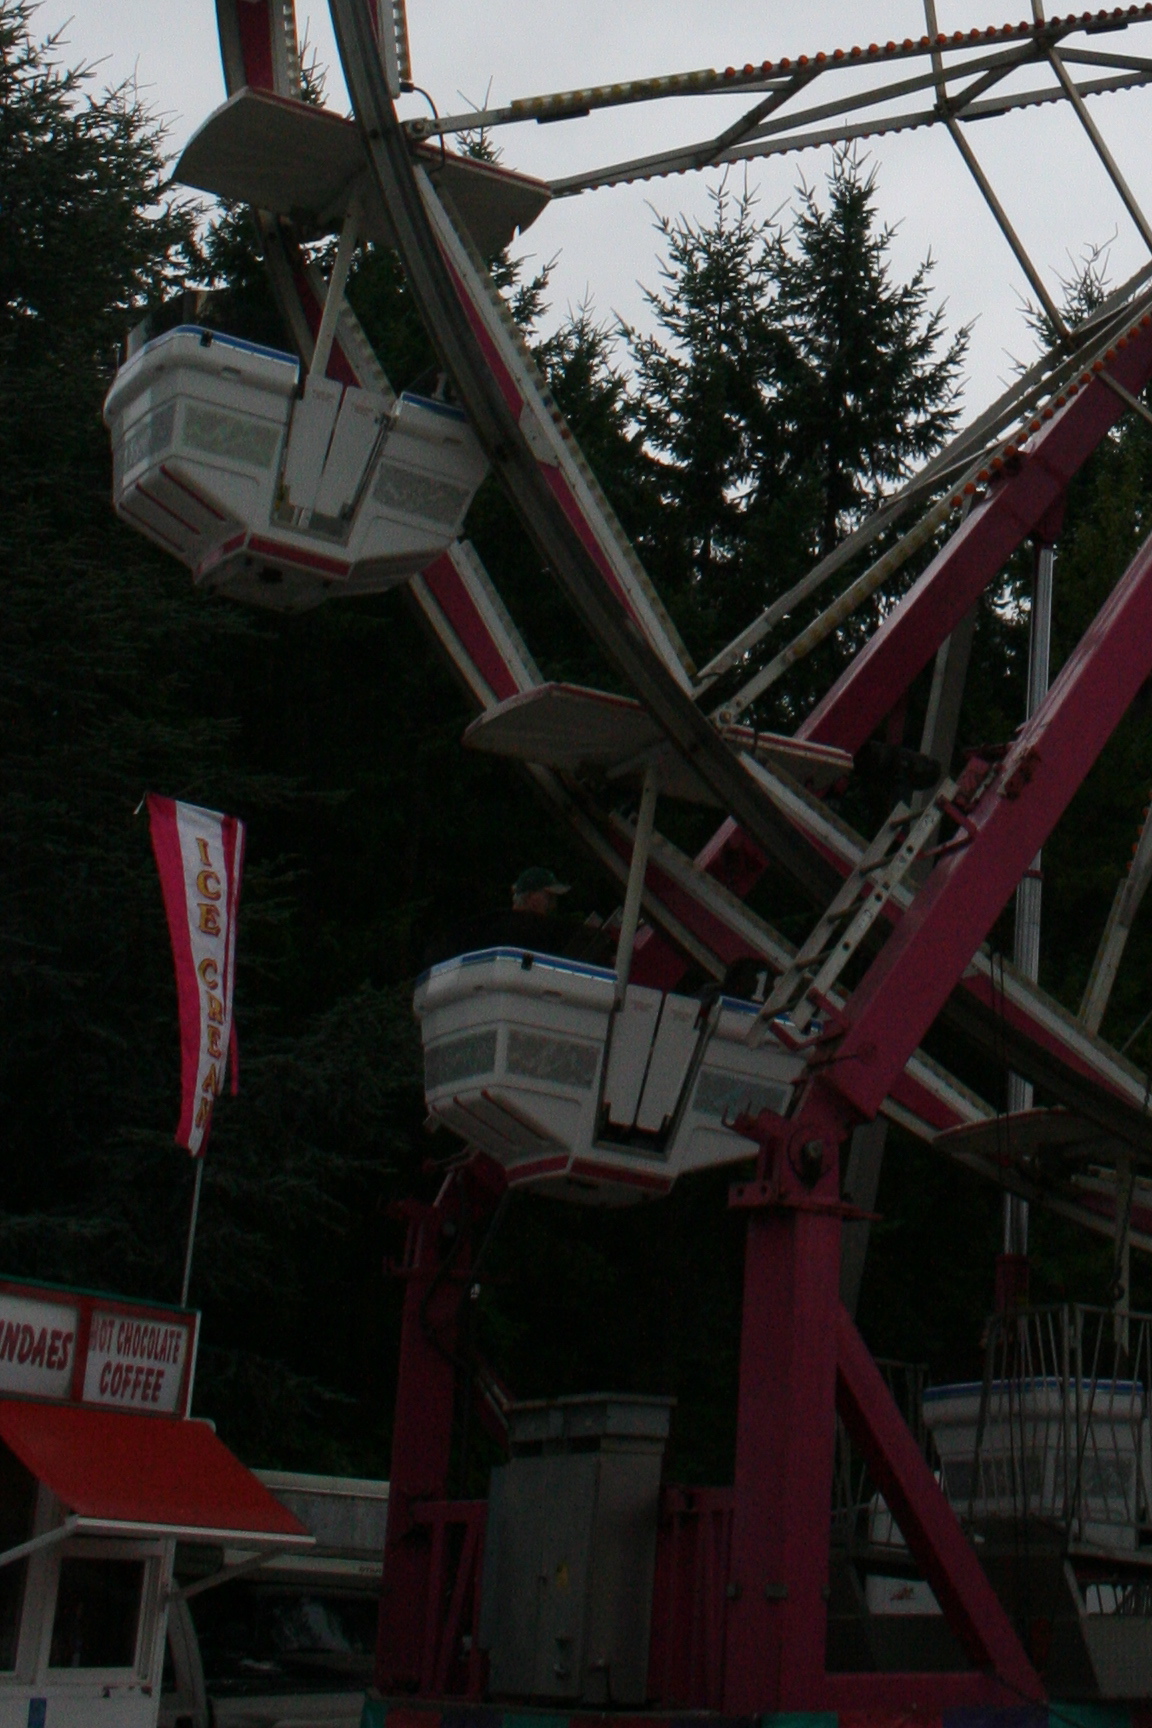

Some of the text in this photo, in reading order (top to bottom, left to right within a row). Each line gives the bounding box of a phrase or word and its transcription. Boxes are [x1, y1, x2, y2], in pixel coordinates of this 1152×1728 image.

[195, 837, 222, 937] ICE
[90, 1316, 183, 1364] HOT CHOCOLATE
[99, 1360, 165, 1403] COFFEE
